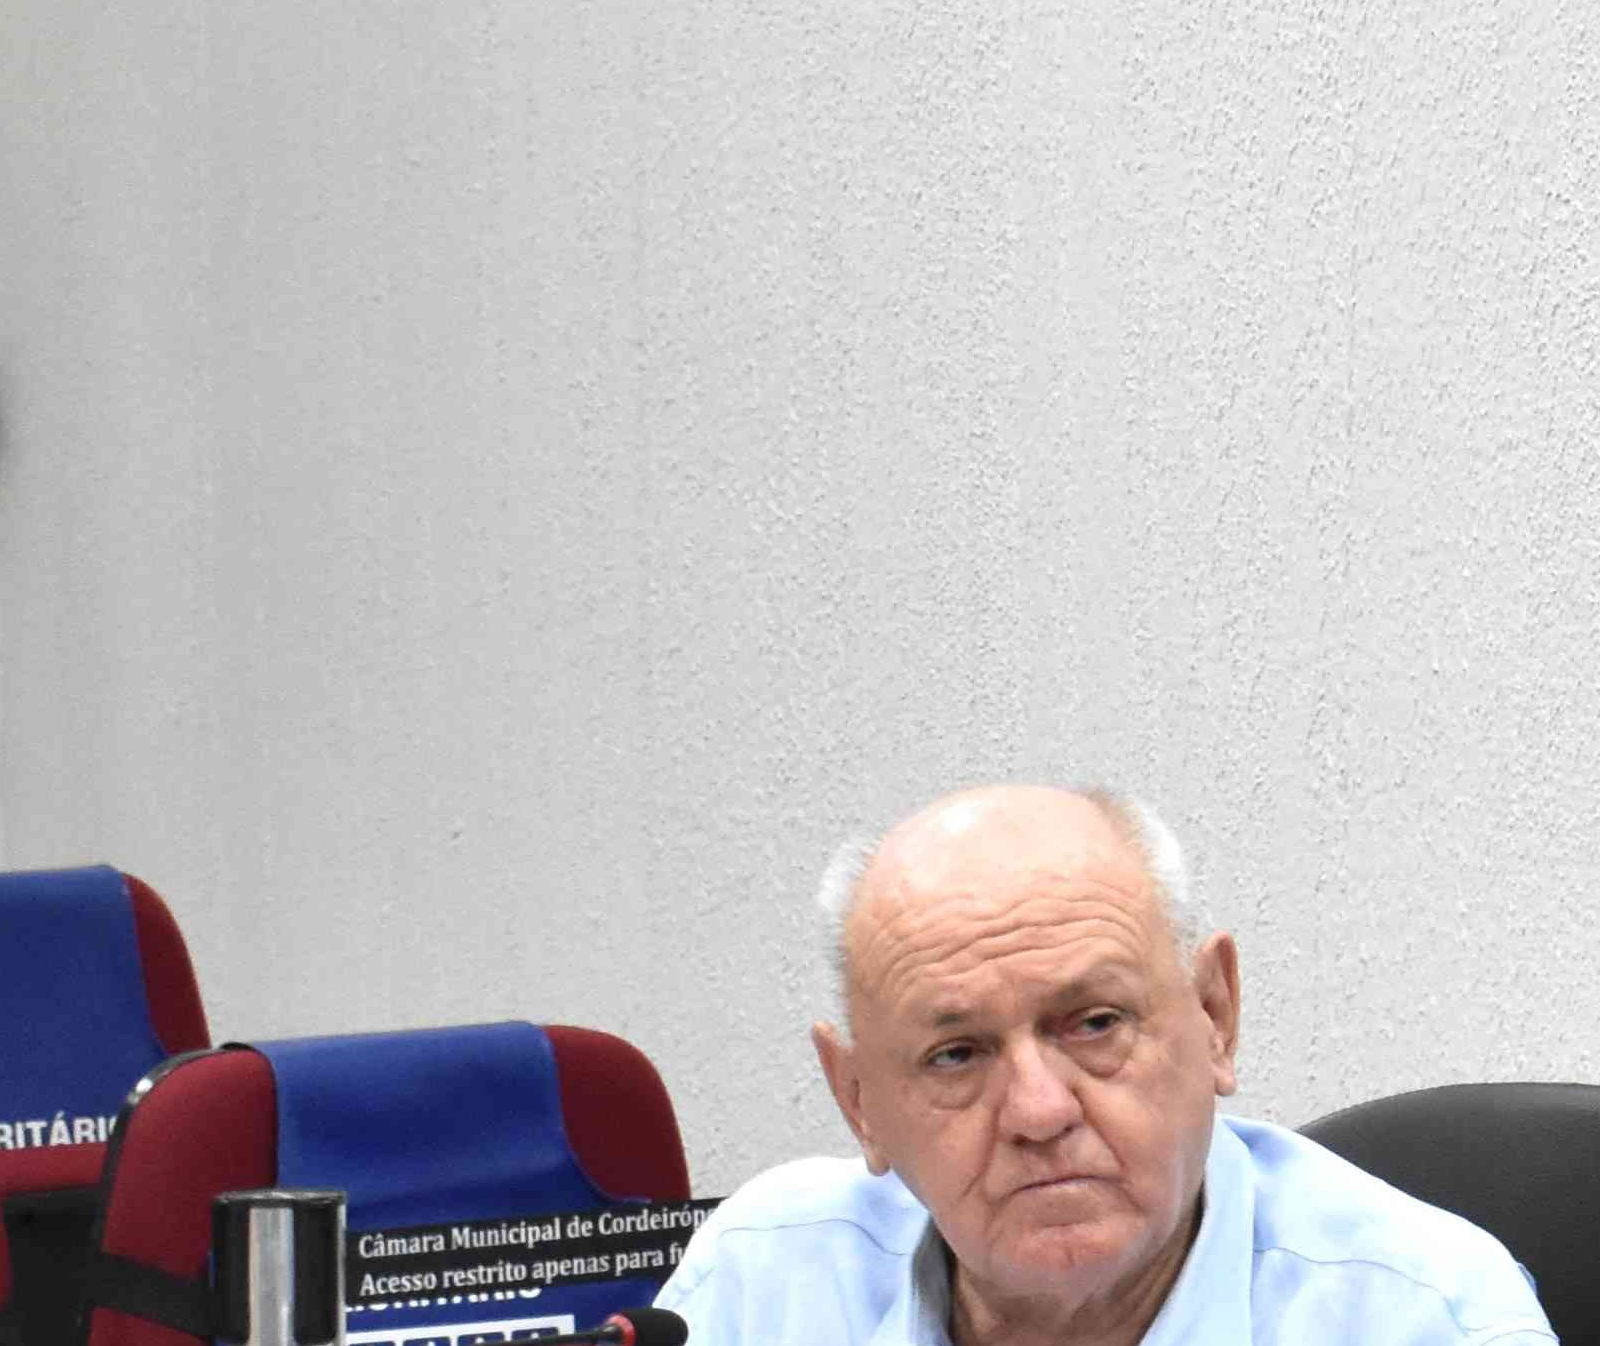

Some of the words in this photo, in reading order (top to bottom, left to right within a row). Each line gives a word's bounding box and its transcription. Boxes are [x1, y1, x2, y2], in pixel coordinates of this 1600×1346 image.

[359, 1233, 445, 1258] Câmara
[451, 1217, 561, 1249] Municipal
[567, 1214, 594, 1239] de
[599, 1203, 713, 1236] Cordeiróp
[360, 1273, 437, 1296] Acesso
[442, 1260, 527, 1288] restrito
[532, 1253, 610, 1284] apenas
[615, 1247, 664, 1276] para
